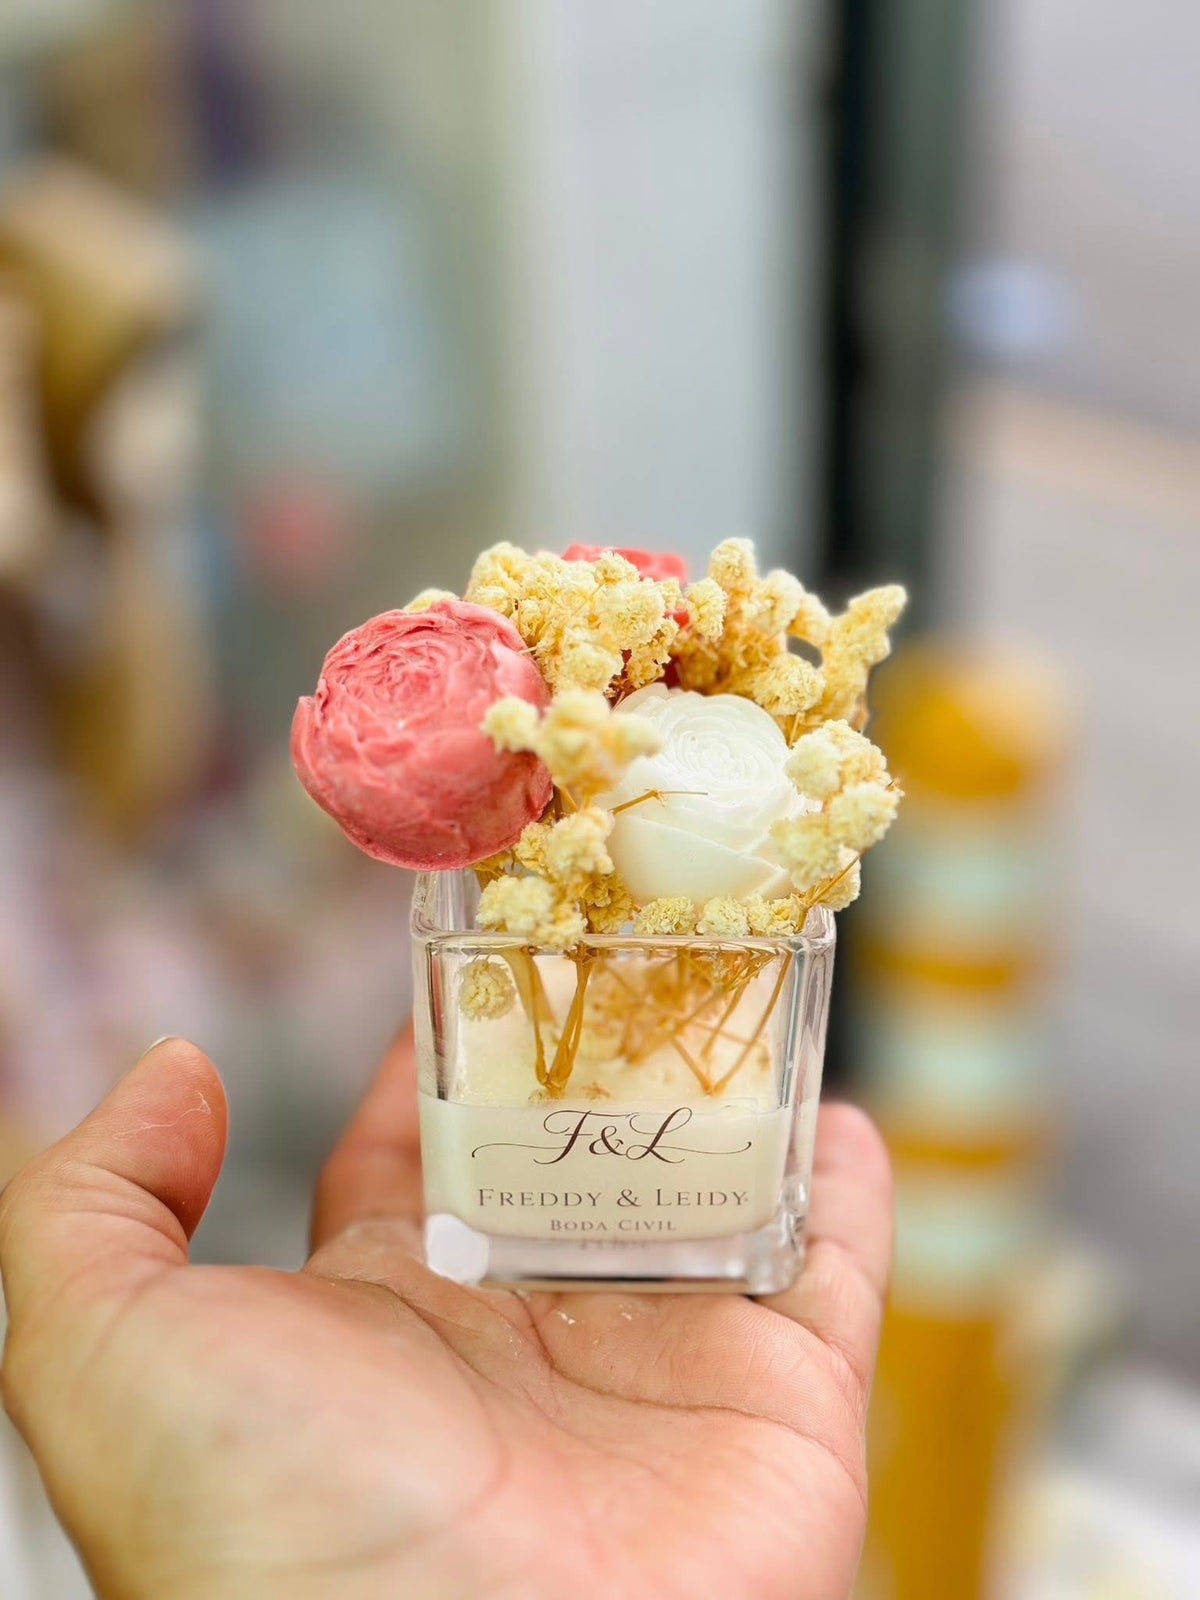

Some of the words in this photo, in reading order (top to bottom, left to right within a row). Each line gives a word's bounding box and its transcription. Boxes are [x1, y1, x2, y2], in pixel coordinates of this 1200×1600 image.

[471, 1106, 752, 1164] F&L
[477, 1188, 602, 1207] FREDDY
[616, 1188, 642, 1207] &
[656, 1188, 747, 1207] LEIDY
[550, 1219, 608, 1232] BODA
[618, 1218, 677, 1232] CIVIL
